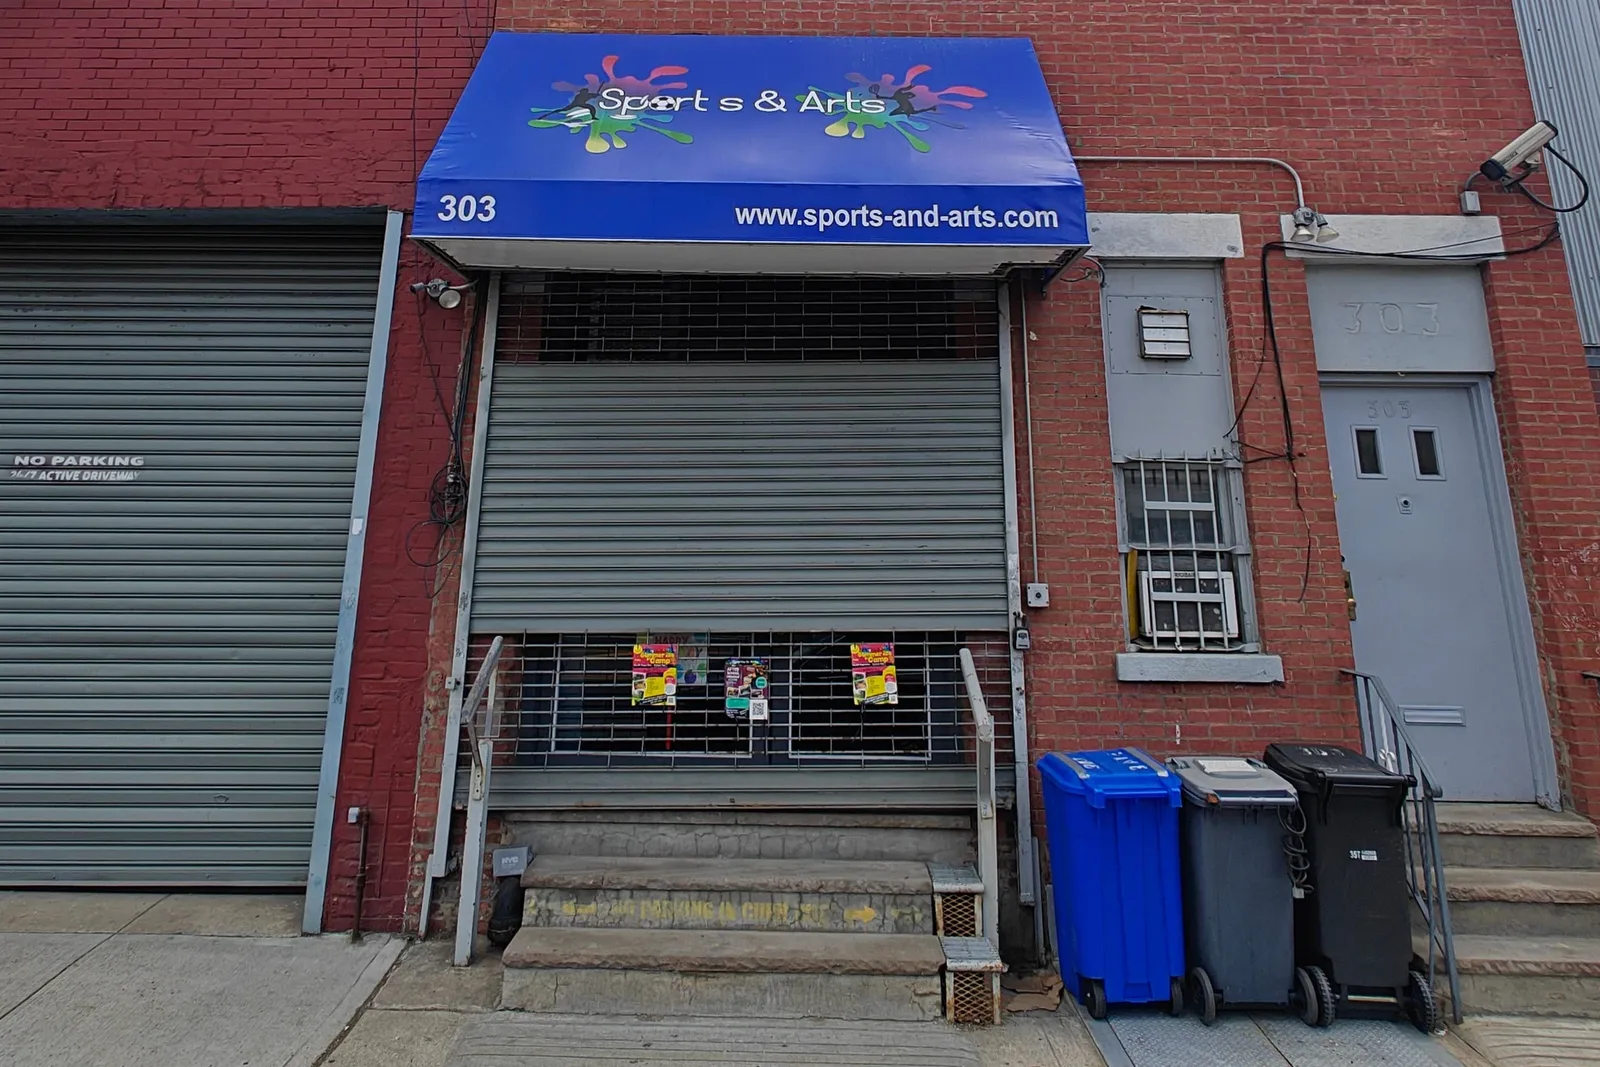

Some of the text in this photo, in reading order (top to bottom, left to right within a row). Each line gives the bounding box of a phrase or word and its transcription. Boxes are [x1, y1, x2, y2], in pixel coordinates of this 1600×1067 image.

[754, 90, 788, 112] &
[800, 90, 885, 113] Arts
[438, 195, 496, 222] 303
[734, 205, 1059, 231] www.sports-and-arts.com
[1341, 303, 1441, 336] 303
[14, 455, 144, 466] NO PARKING
[38, 470, 79, 481] ACTIVE
[82, 470, 140, 481] DRIVEWAY
